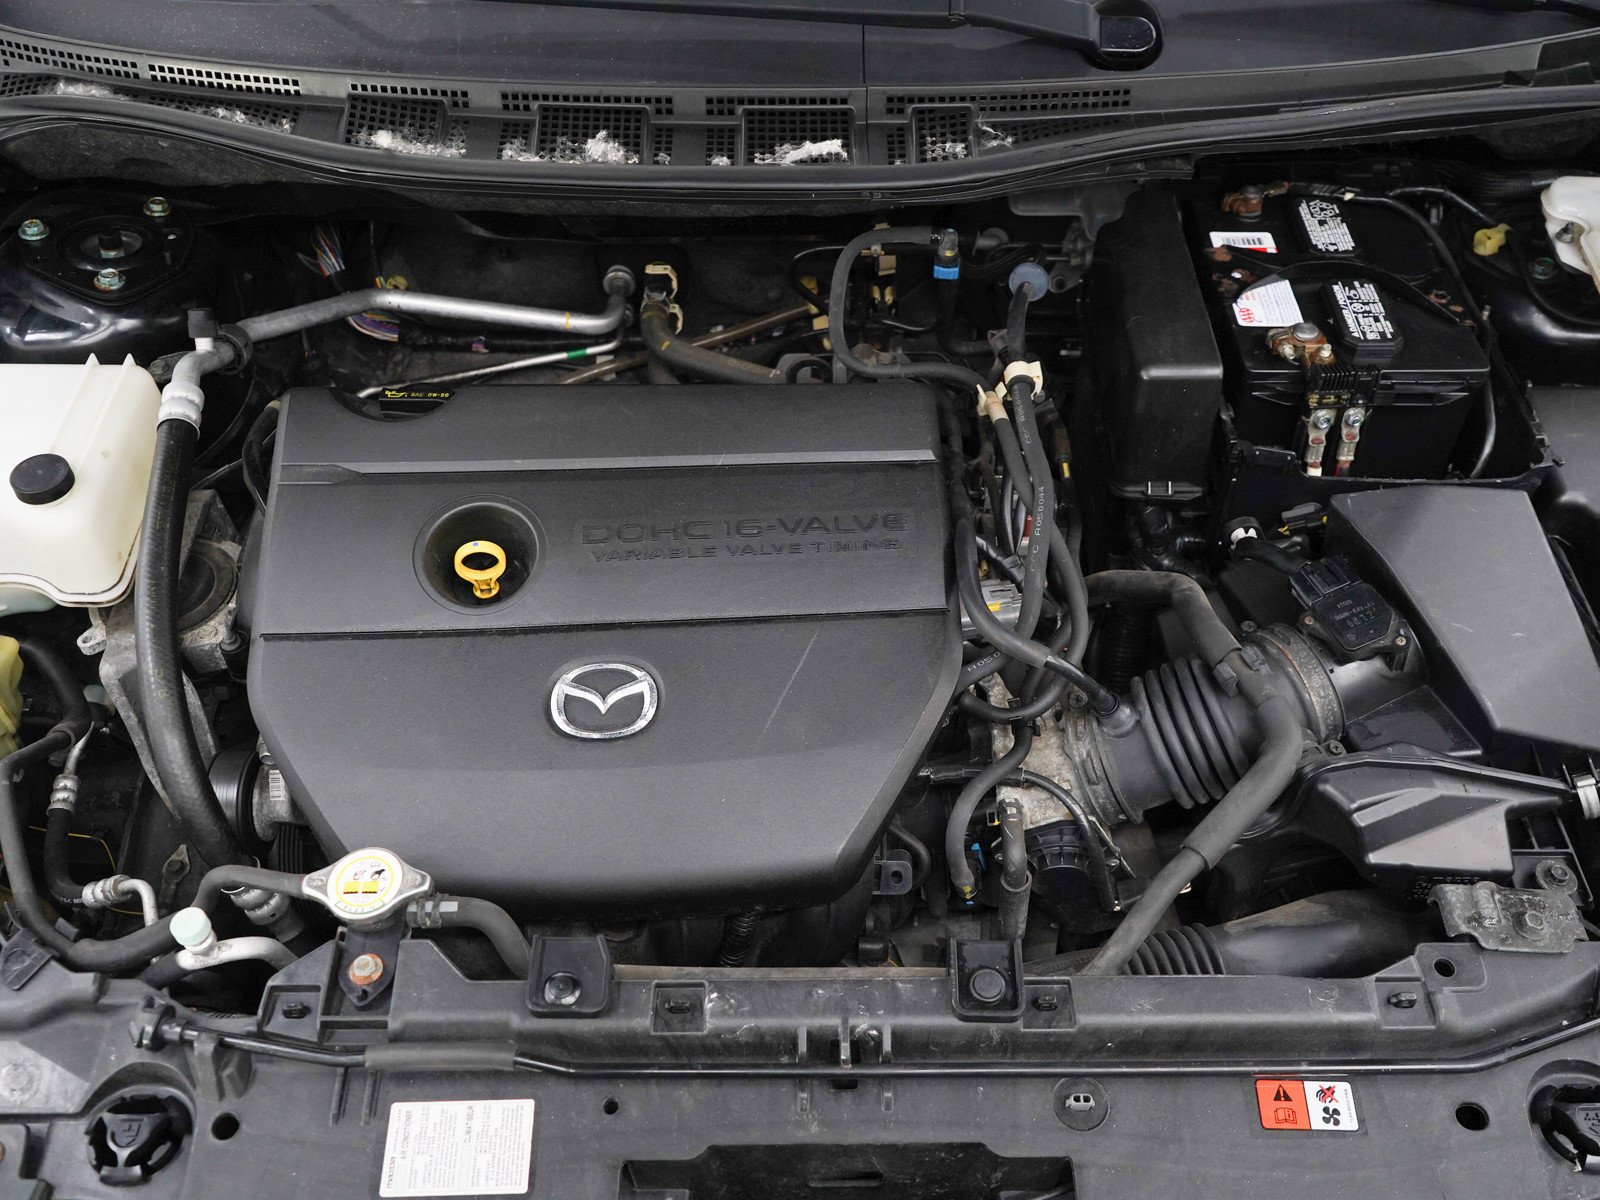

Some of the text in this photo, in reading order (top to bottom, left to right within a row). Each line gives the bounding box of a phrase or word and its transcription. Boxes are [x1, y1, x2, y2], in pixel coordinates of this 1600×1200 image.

[582, 513, 910, 545] DOHC 16-VALVE
[591, 538, 900, 563] VARIABLE VALVE TIMING
